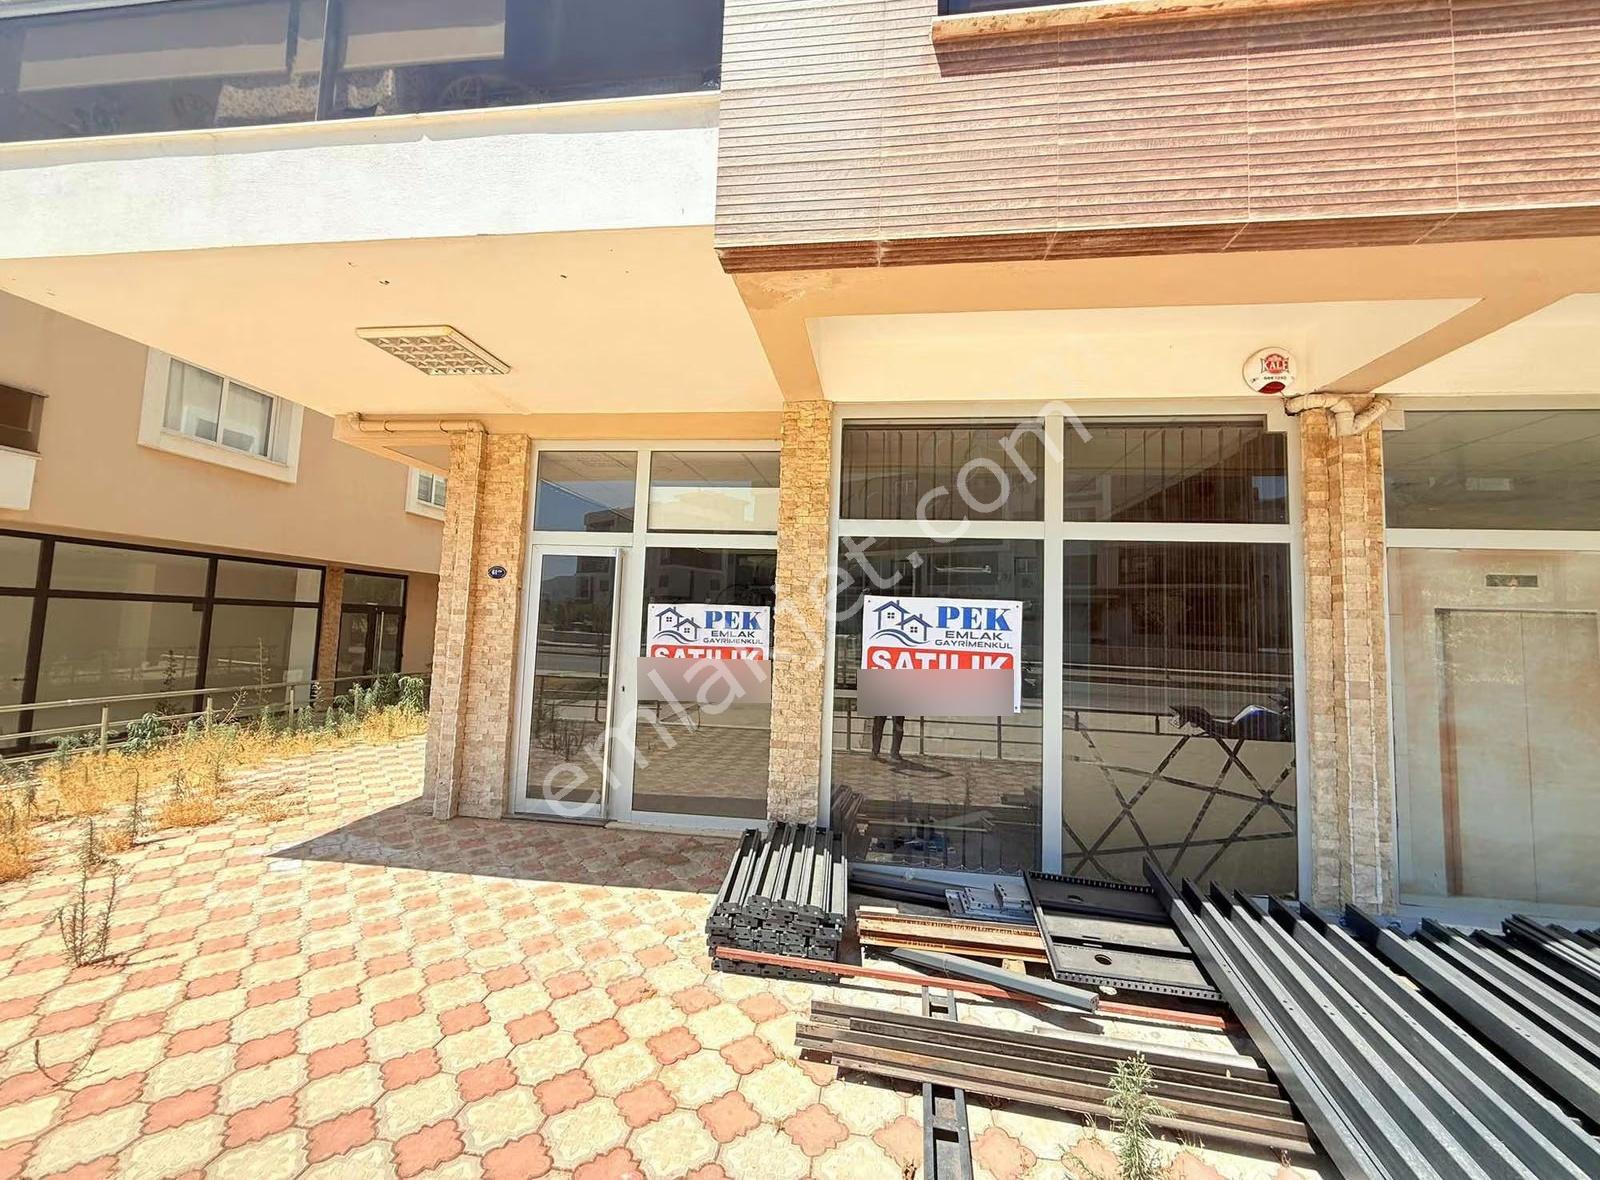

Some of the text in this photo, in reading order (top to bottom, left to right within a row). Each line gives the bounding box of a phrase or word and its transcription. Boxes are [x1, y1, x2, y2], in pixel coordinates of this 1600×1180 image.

[704, 610, 762, 630] PEK
[936, 605, 1012, 631] PEK
[711, 630, 755, 638] EMLAK
[945, 630, 1003, 641] EMLAK
[935, 639, 1013, 650] GAYRİMENKUL
